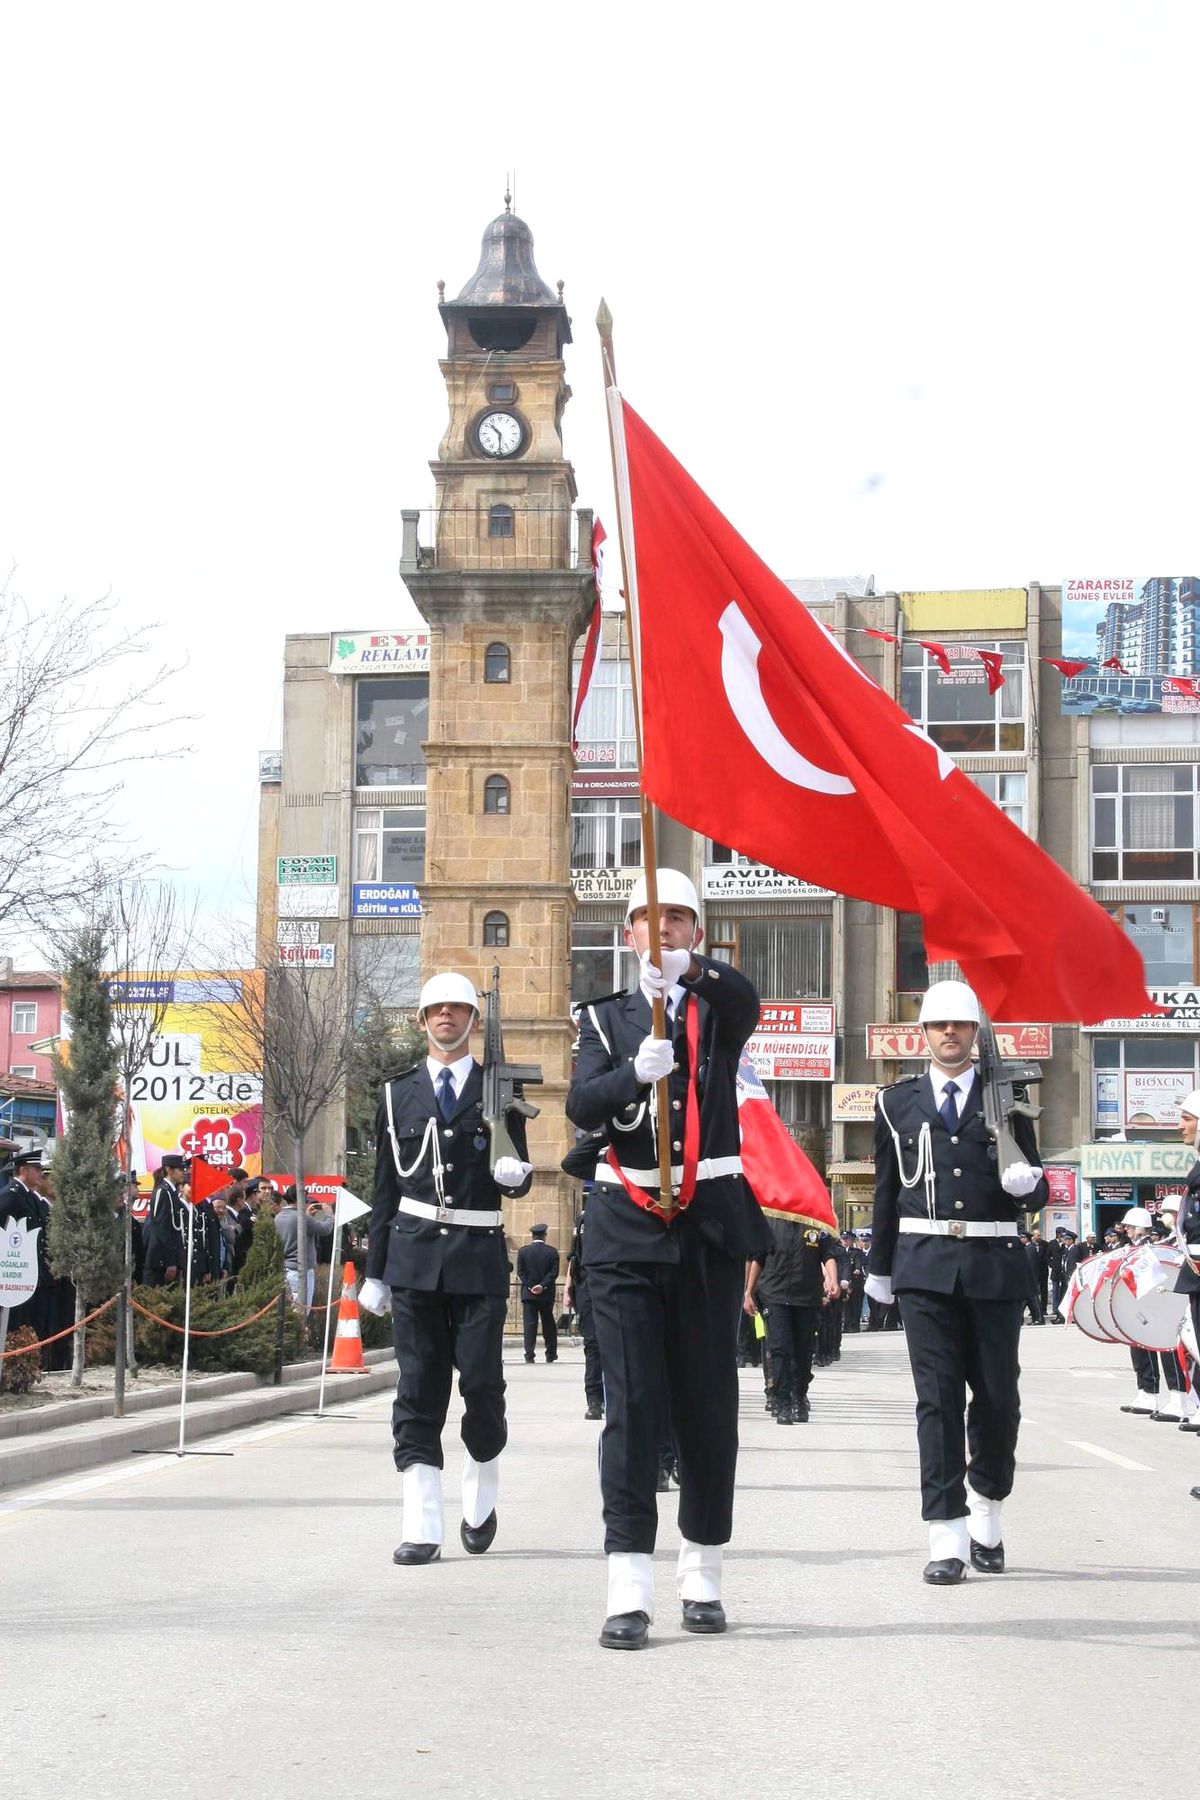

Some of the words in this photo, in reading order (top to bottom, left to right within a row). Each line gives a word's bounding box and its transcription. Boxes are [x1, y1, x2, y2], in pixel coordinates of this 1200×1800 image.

[1067, 579, 1134, 591] ZARARSIZ
[1067, 590, 1100, 602] GÜNEŞ
[1103, 592, 1134, 600] EVLER
[360, 647, 428, 662] REKLAM
[600, 749, 616, 762] 23
[596, 879, 637, 891] YILDIR
[739, 879, 783, 888] TUFAN
[359, 886, 410, 900] ERDOĞAN
[357, 902, 388, 913] EĞİTİM
[389, 905, 400, 913] ve
[760, 1009, 796, 1021] an
[1135, 1020, 1149, 1028] 245
[763, 1041, 829, 1055] MÜHENDİSLİK
[131, 1075, 254, 1101] 2012'de
[193, 1105, 231, 1115] ÜSTELİK
[1087, 1151, 1144, 1170] HAYAT
[282, 1182, 339, 1194] vfone
[7, 1250, 21, 1258] LALE
